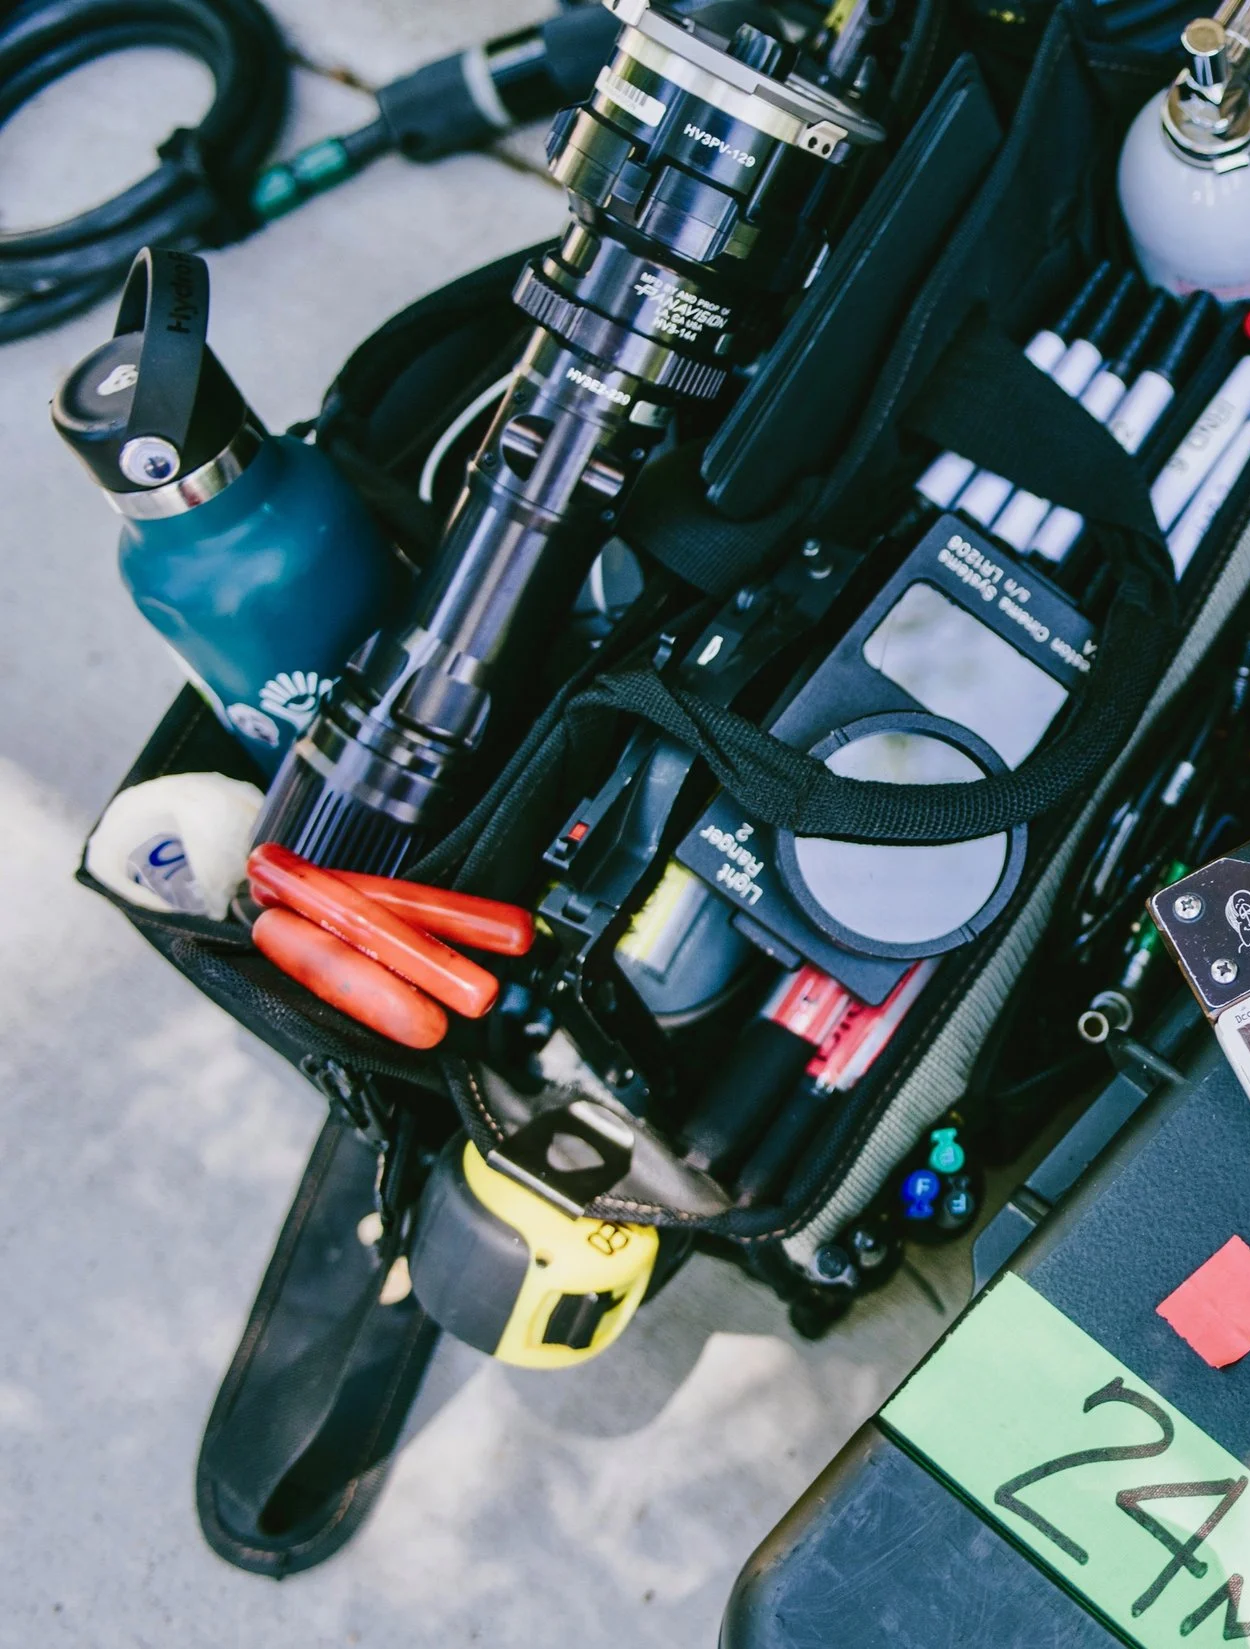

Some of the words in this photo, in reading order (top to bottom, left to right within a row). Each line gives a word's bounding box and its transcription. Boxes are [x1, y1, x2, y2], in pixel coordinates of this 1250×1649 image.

[937, 548, 998, 602] Systems
[998, 596, 1050, 643] Cinema
[699, 825, 765, 878] Ranger
[735, 822, 754, 842] 2
[716, 863, 764, 906] Light
[916, 1178, 931, 1196] F
